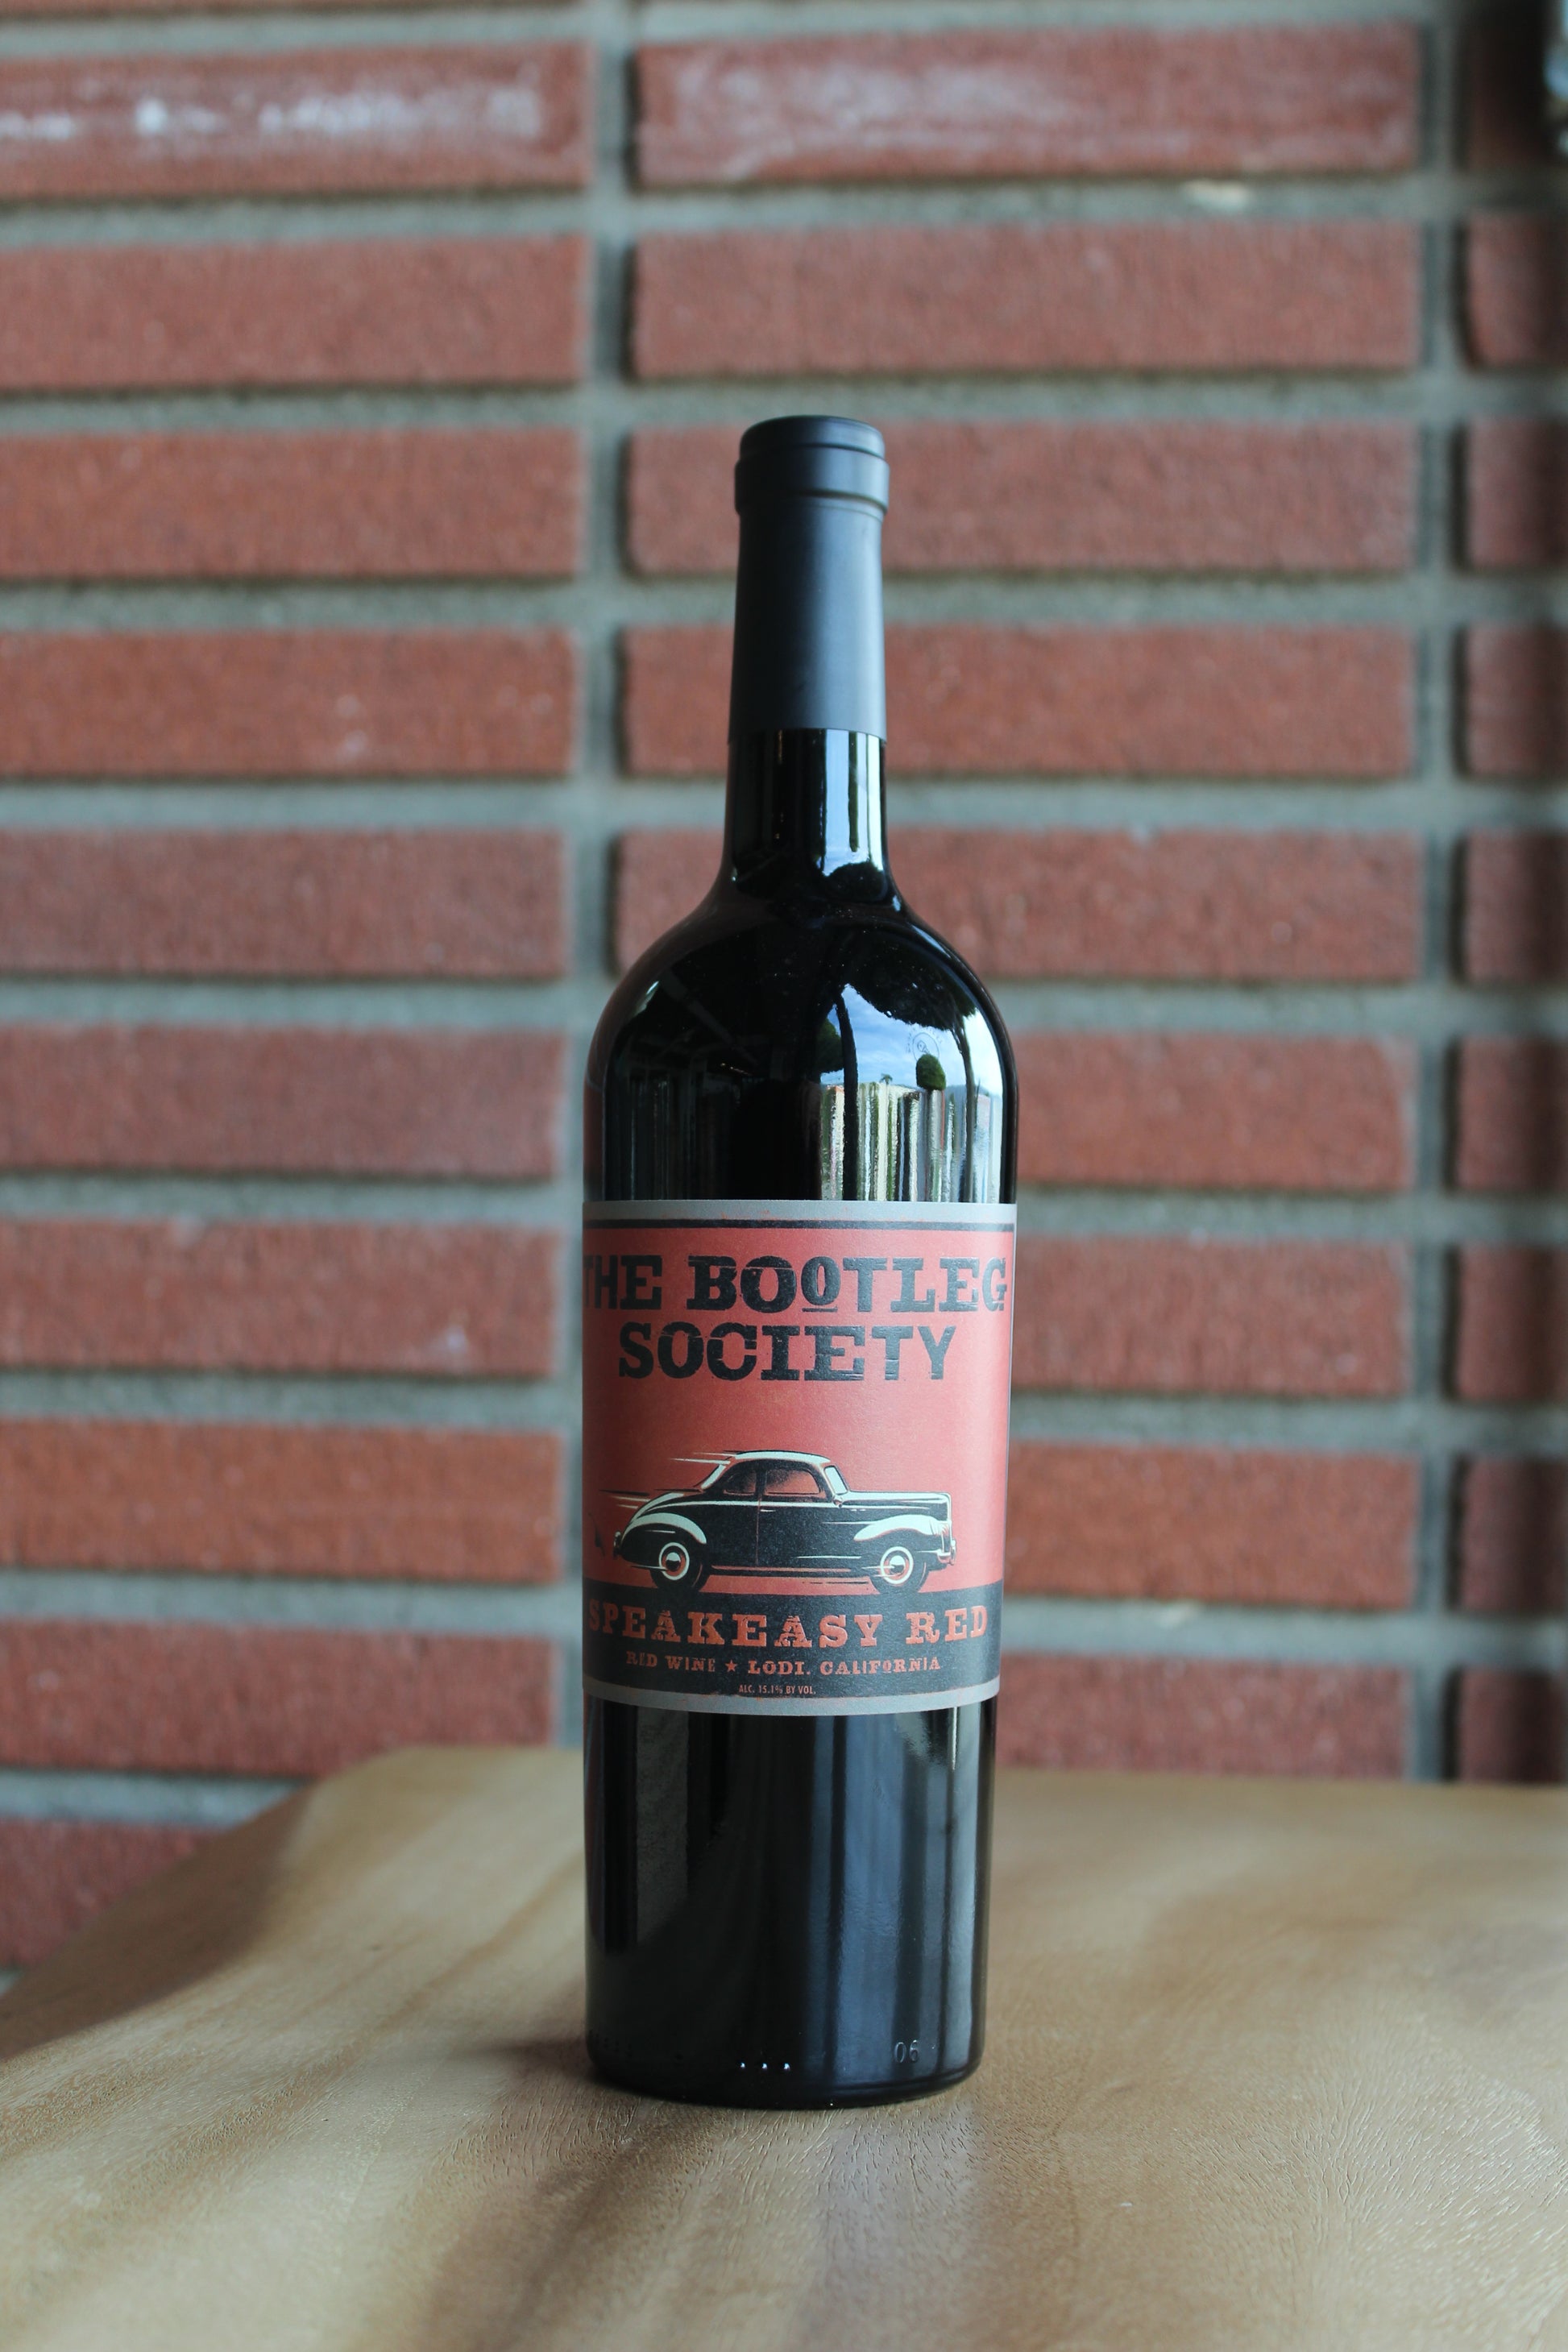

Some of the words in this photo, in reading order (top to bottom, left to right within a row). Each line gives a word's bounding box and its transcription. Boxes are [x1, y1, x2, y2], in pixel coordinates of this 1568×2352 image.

[583, 1255, 662, 1310] THE
[687, 1255, 1007, 1313] BOOTLEG
[618, 1321, 956, 1381] SOCIETY
[588, 1600, 884, 1649] SPEAKEASY
[905, 1605, 989, 1645] RED
[625, 1651, 657, 1669] RED
[665, 1655, 716, 1673] WINE
[819, 1656, 941, 1675] CALIFORNIA
[739, 1684, 756, 1694] ALC.
[786, 1685, 796, 1695] BY
[798, 1686, 816, 1695] VOL.
